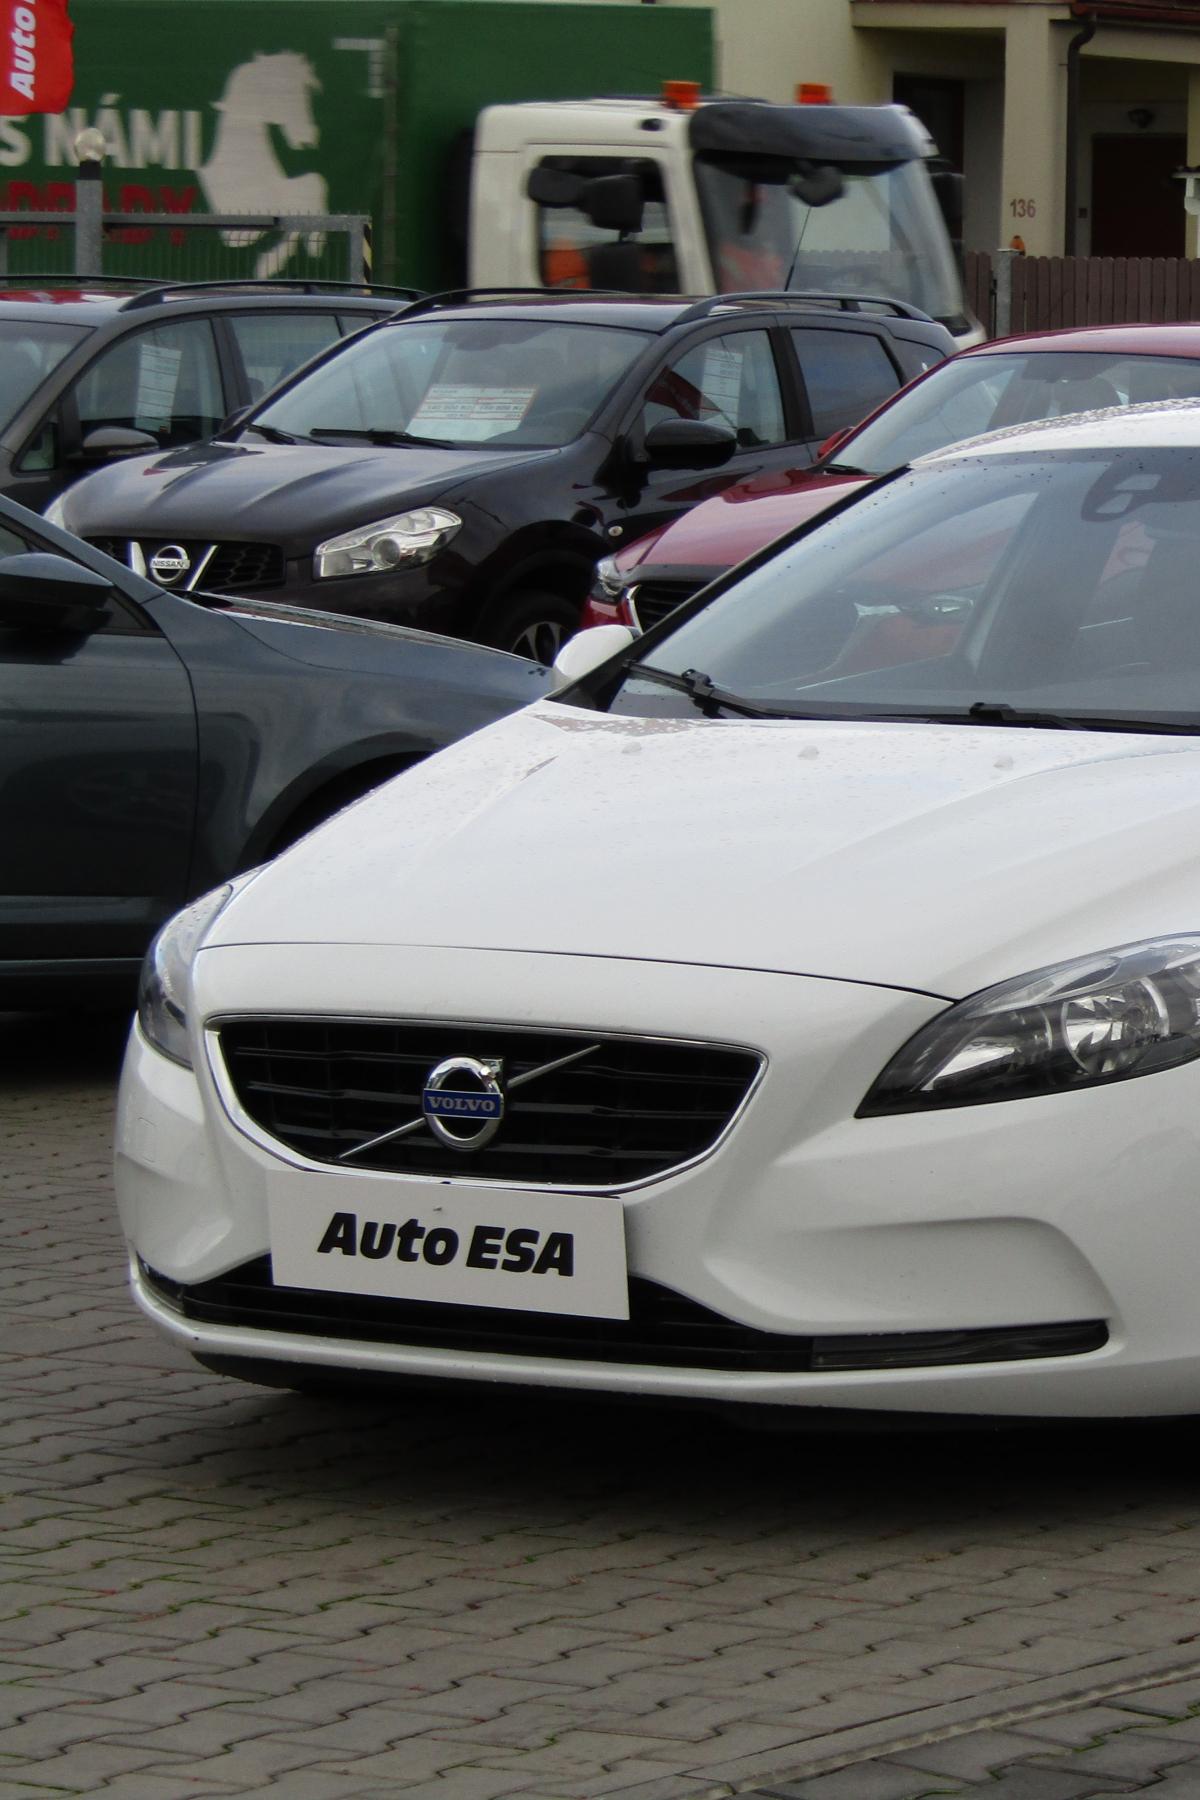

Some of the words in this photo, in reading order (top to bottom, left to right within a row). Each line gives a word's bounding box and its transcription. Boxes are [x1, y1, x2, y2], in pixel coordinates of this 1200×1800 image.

[10, 6, 36, 100] Auto
[44, 92, 201, 171] NÁMI
[1009, 199, 1037, 218] 136
[152, 559, 185, 568] NISSAN
[428, 1096, 496, 1113] VOLVO
[317, 1212, 459, 1266] Auto
[465, 1225, 575, 1278] ESA
